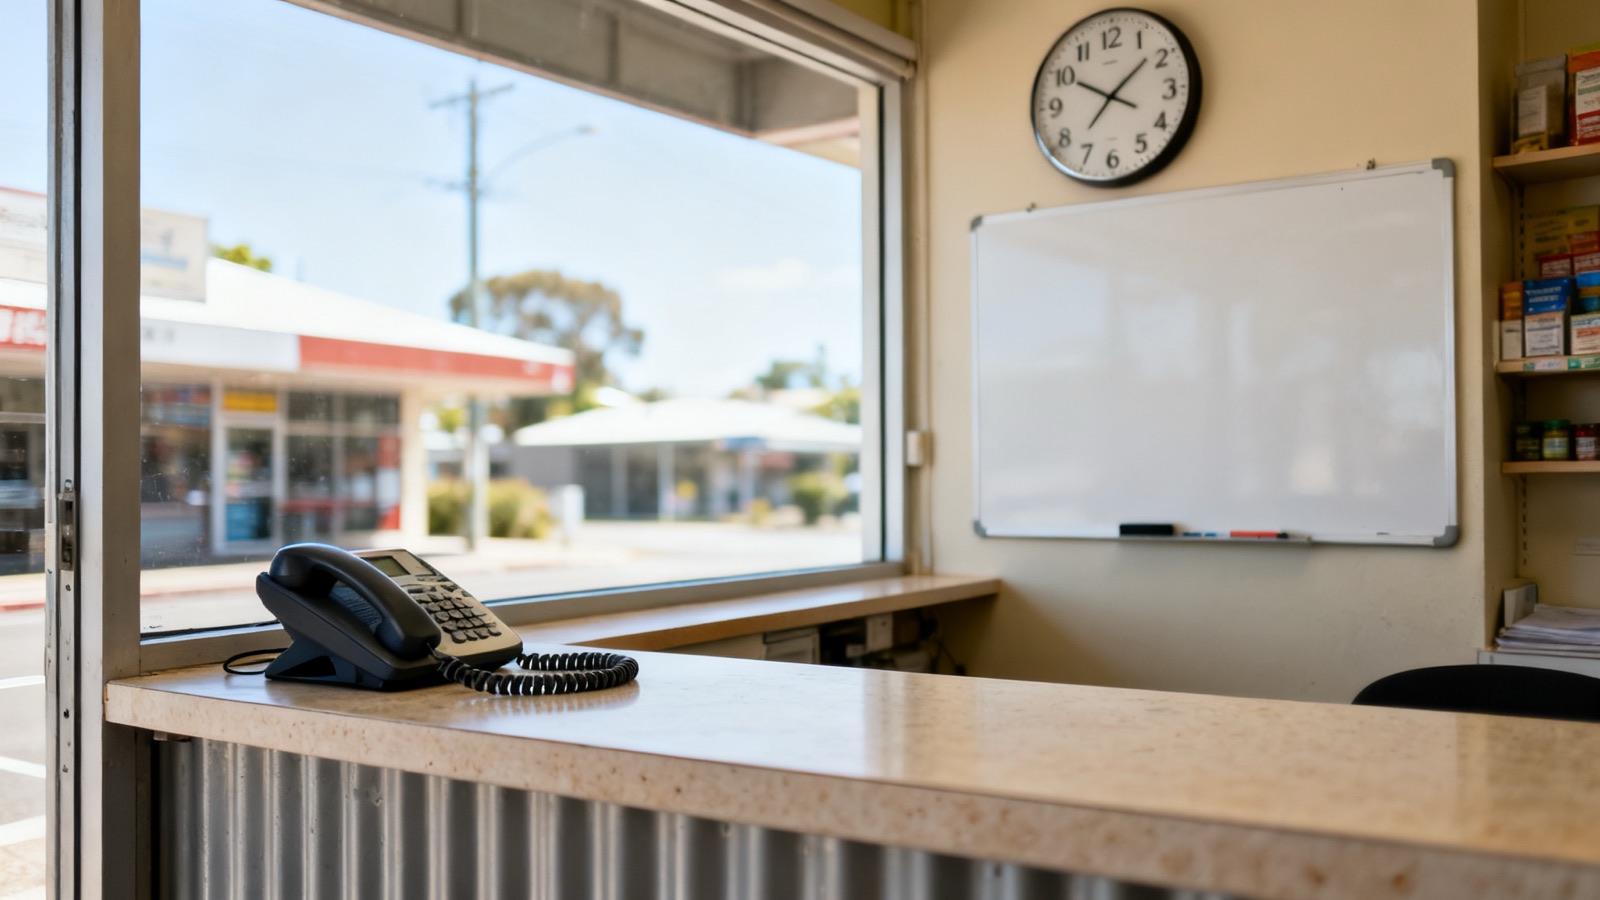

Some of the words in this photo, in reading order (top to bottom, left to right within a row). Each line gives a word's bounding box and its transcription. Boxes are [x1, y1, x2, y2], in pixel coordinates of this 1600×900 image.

[1103, 27, 1121, 50] 12
[1137, 30, 1142, 49] 1
[1077, 42, 1089, 62] 11
[1155, 48, 1169, 68] 2
[1055, 65, 1075, 87] 10
[1162, 77, 1177, 100] 3
[1049, 98, 1063, 118] 9
[1154, 111, 1167, 130] 4
[1058, 128, 1071, 148] 8
[1135, 133, 1147, 154] 5
[1080, 143, 1094, 165] 7
[1107, 151, 1119, 168] 6
